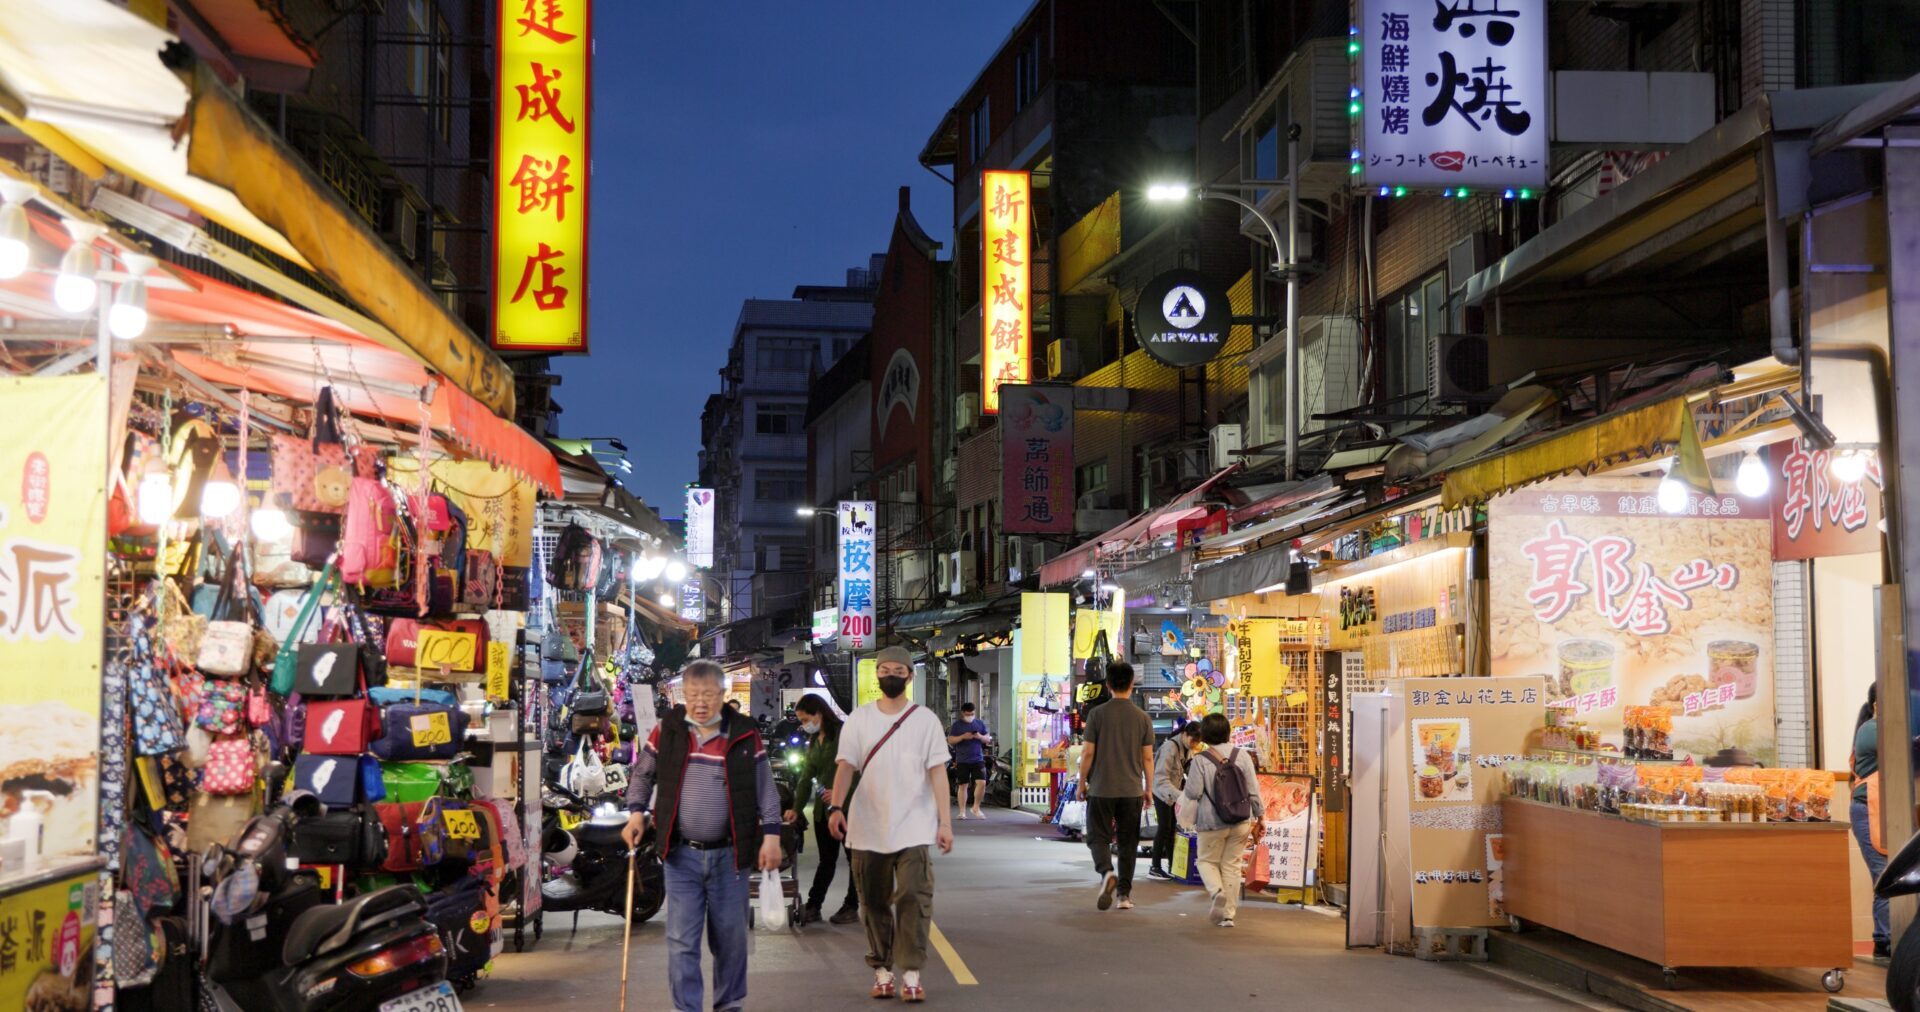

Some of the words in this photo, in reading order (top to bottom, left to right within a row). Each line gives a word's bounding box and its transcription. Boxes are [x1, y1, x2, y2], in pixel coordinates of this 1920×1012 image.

[1381, 12, 1410, 136] 海鮮燒烤
[510, 0, 577, 311] 建成餅店
[1370, 153, 1426, 167] シーフード
[1467, 154, 1539, 168] バーベキュー
[1150, 332, 1220, 343] AIRWALK
[1019, 437, 1053, 523] 萬飾通
[1539, 494, 1601, 513] 古早味
[1617, 495, 1741, 516] 健康食品
[842, 538, 872, 612] 按摩
[1520, 519, 1741, 635] 郭金山
[842, 615, 872, 636] 200
[421, 634, 472, 664] 100
[851, 637, 863, 648] 元
[1411, 687, 1538, 706] 郭金山花生店
[1683, 682, 1738, 715] 杏仁酥
[418, 730, 445, 744] 200
[450, 818, 477, 834] 200
